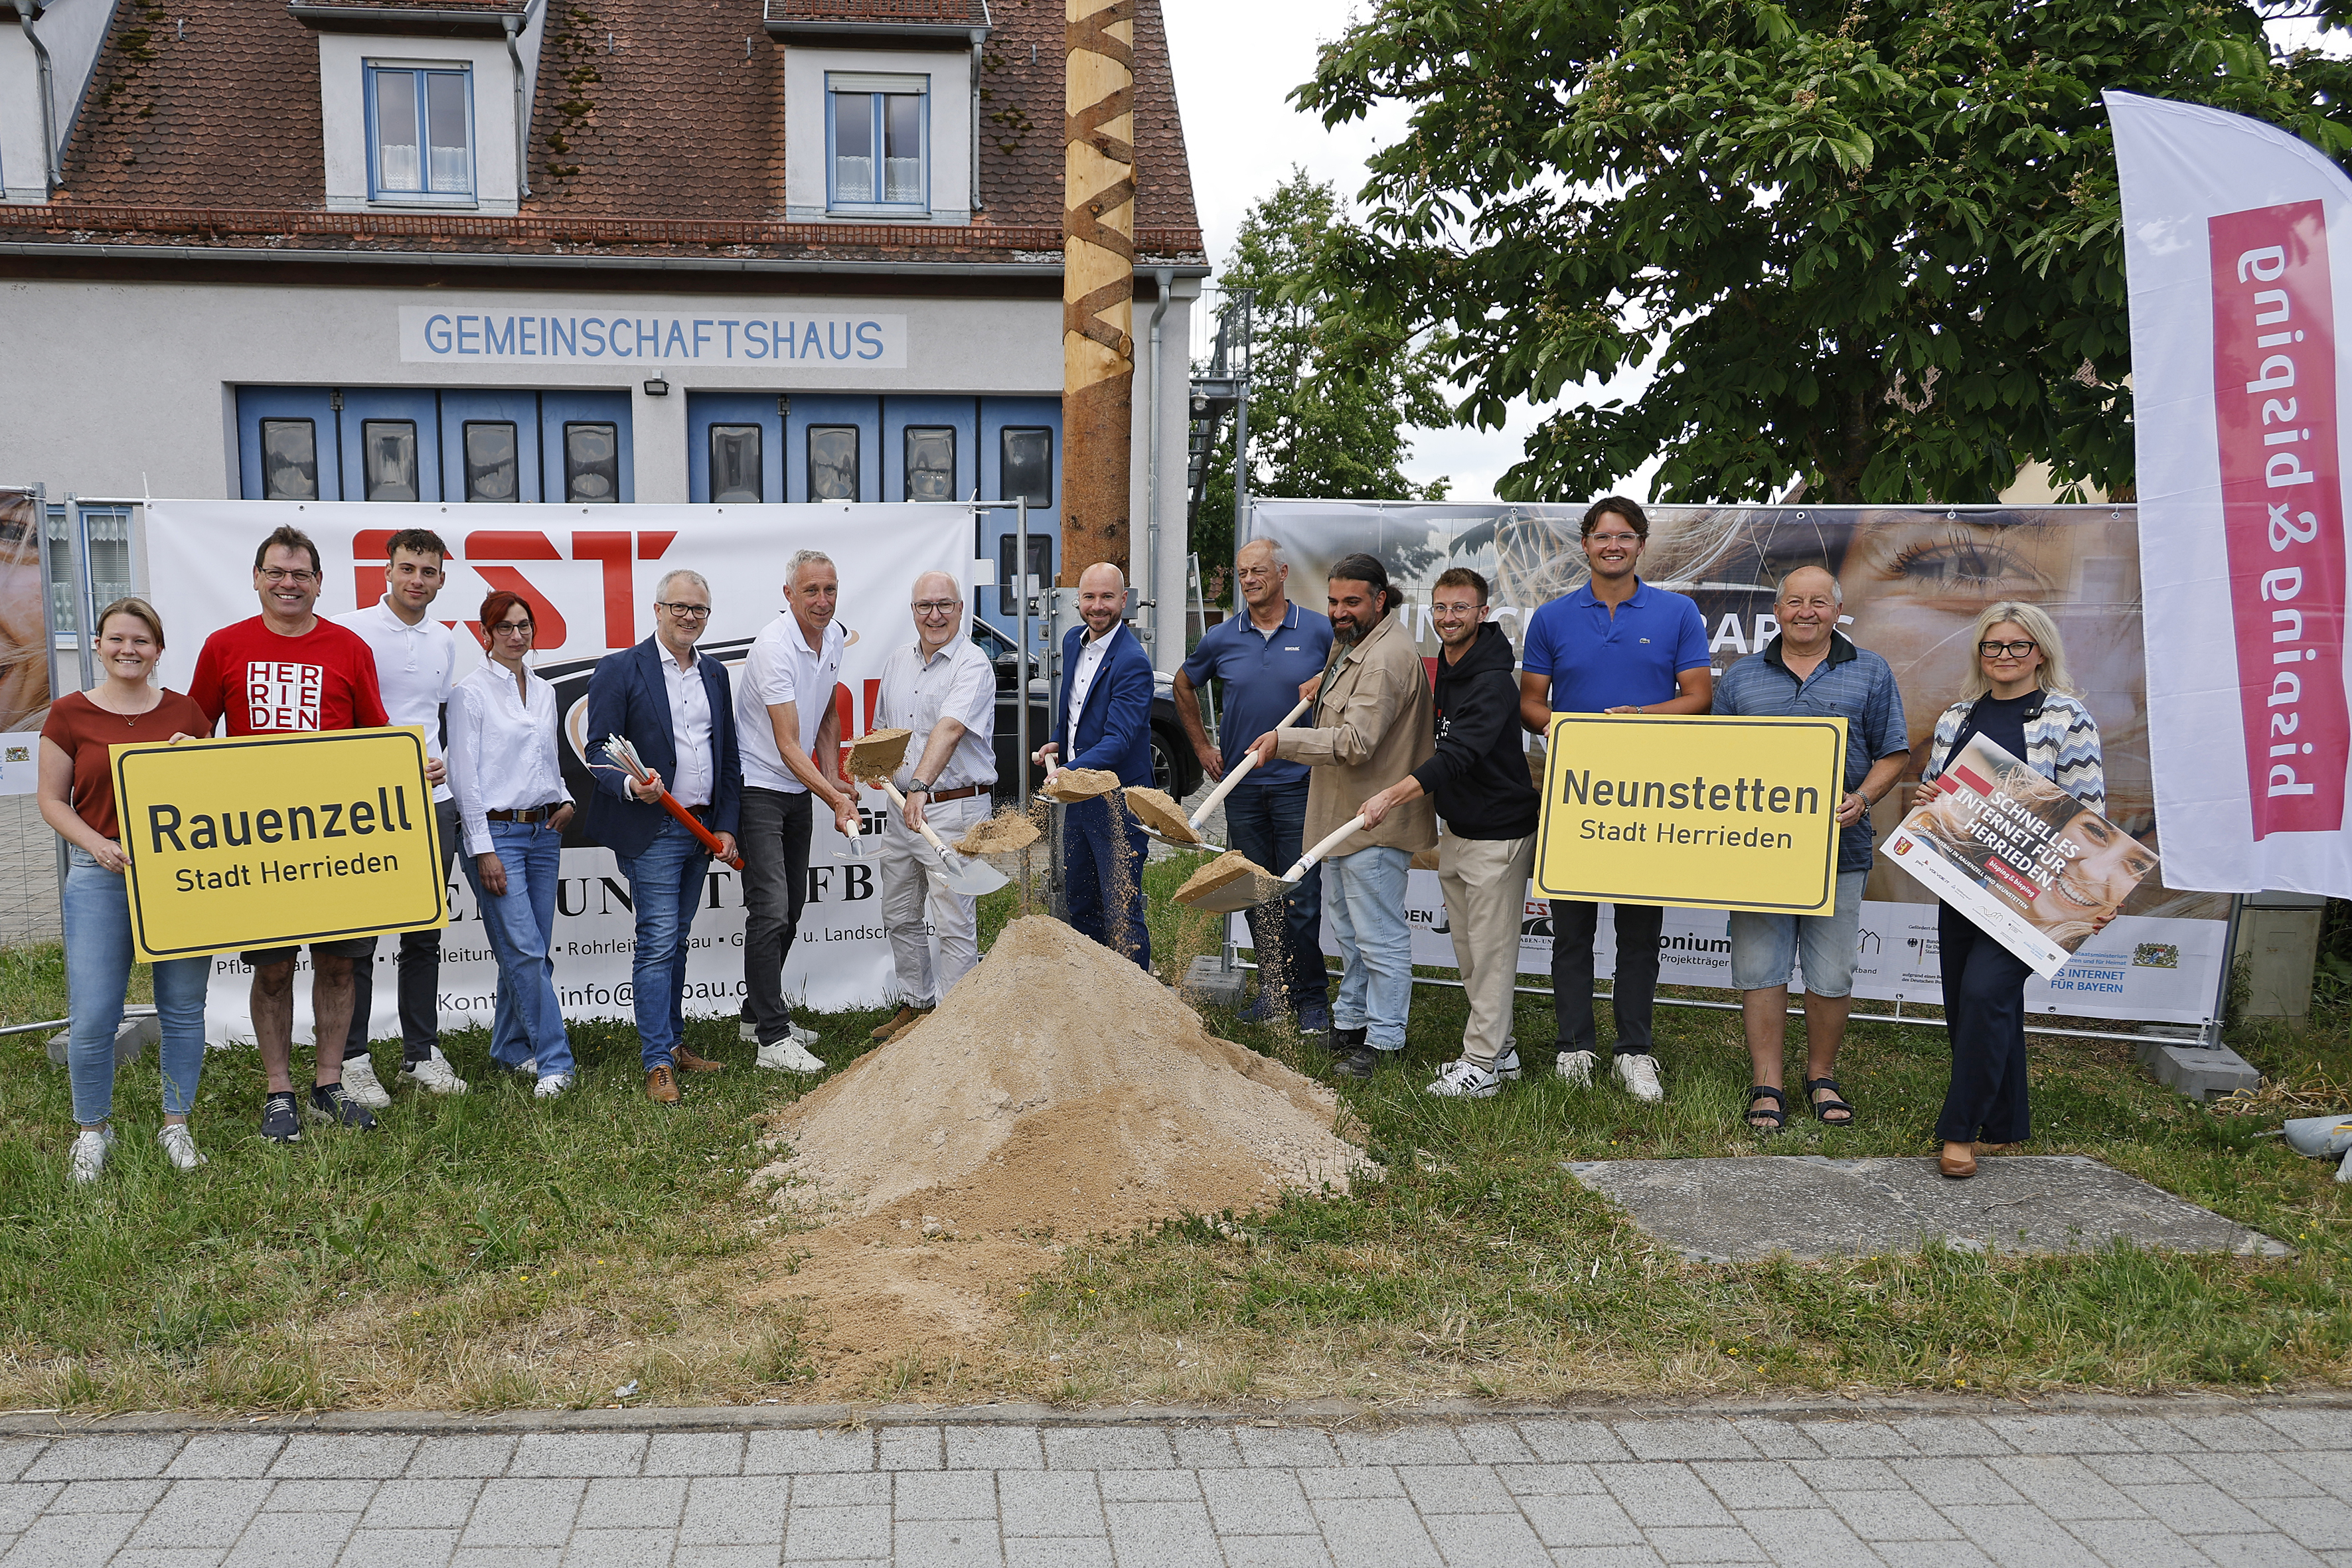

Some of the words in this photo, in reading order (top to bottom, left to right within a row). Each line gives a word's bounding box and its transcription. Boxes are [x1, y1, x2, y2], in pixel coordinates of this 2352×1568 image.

[424, 313, 884, 360] GEMEINSCHAFTSHAUS
[1562, 769, 1819, 815] Neunstetten
[147, 785, 412, 854] Rauenzell
[1579, 819, 1647, 842] Stadt
[1656, 822, 1792, 849] Herrieden
[1955, 788, 2035, 848] INTERNET
[2031, 843, 2066, 874] FÜR
[1990, 791, 2080, 859] SCHNELLES
[176, 864, 251, 892] Stadt
[260, 852, 398, 884] Herrieden
[1911, 820, 1952, 854] GLASFASERAUSBAU
[1958, 855, 1984, 878] RAUENZELL
[1984, 874, 1996, 886] UND
[1994, 881, 2029, 910] NEUNSTETTEN
[1964, 817, 2054, 892] HERRIEDEN.
[1989, 860, 2010, 881] bisping
[2013, 878, 2035, 898] bisping
[1660, 953, 1730, 969] Projektträger
[2069, 969, 2126, 980] INTERNET
[2051, 979, 2074, 990] FÜR
[2077, 982, 2123, 993] BAYERN
